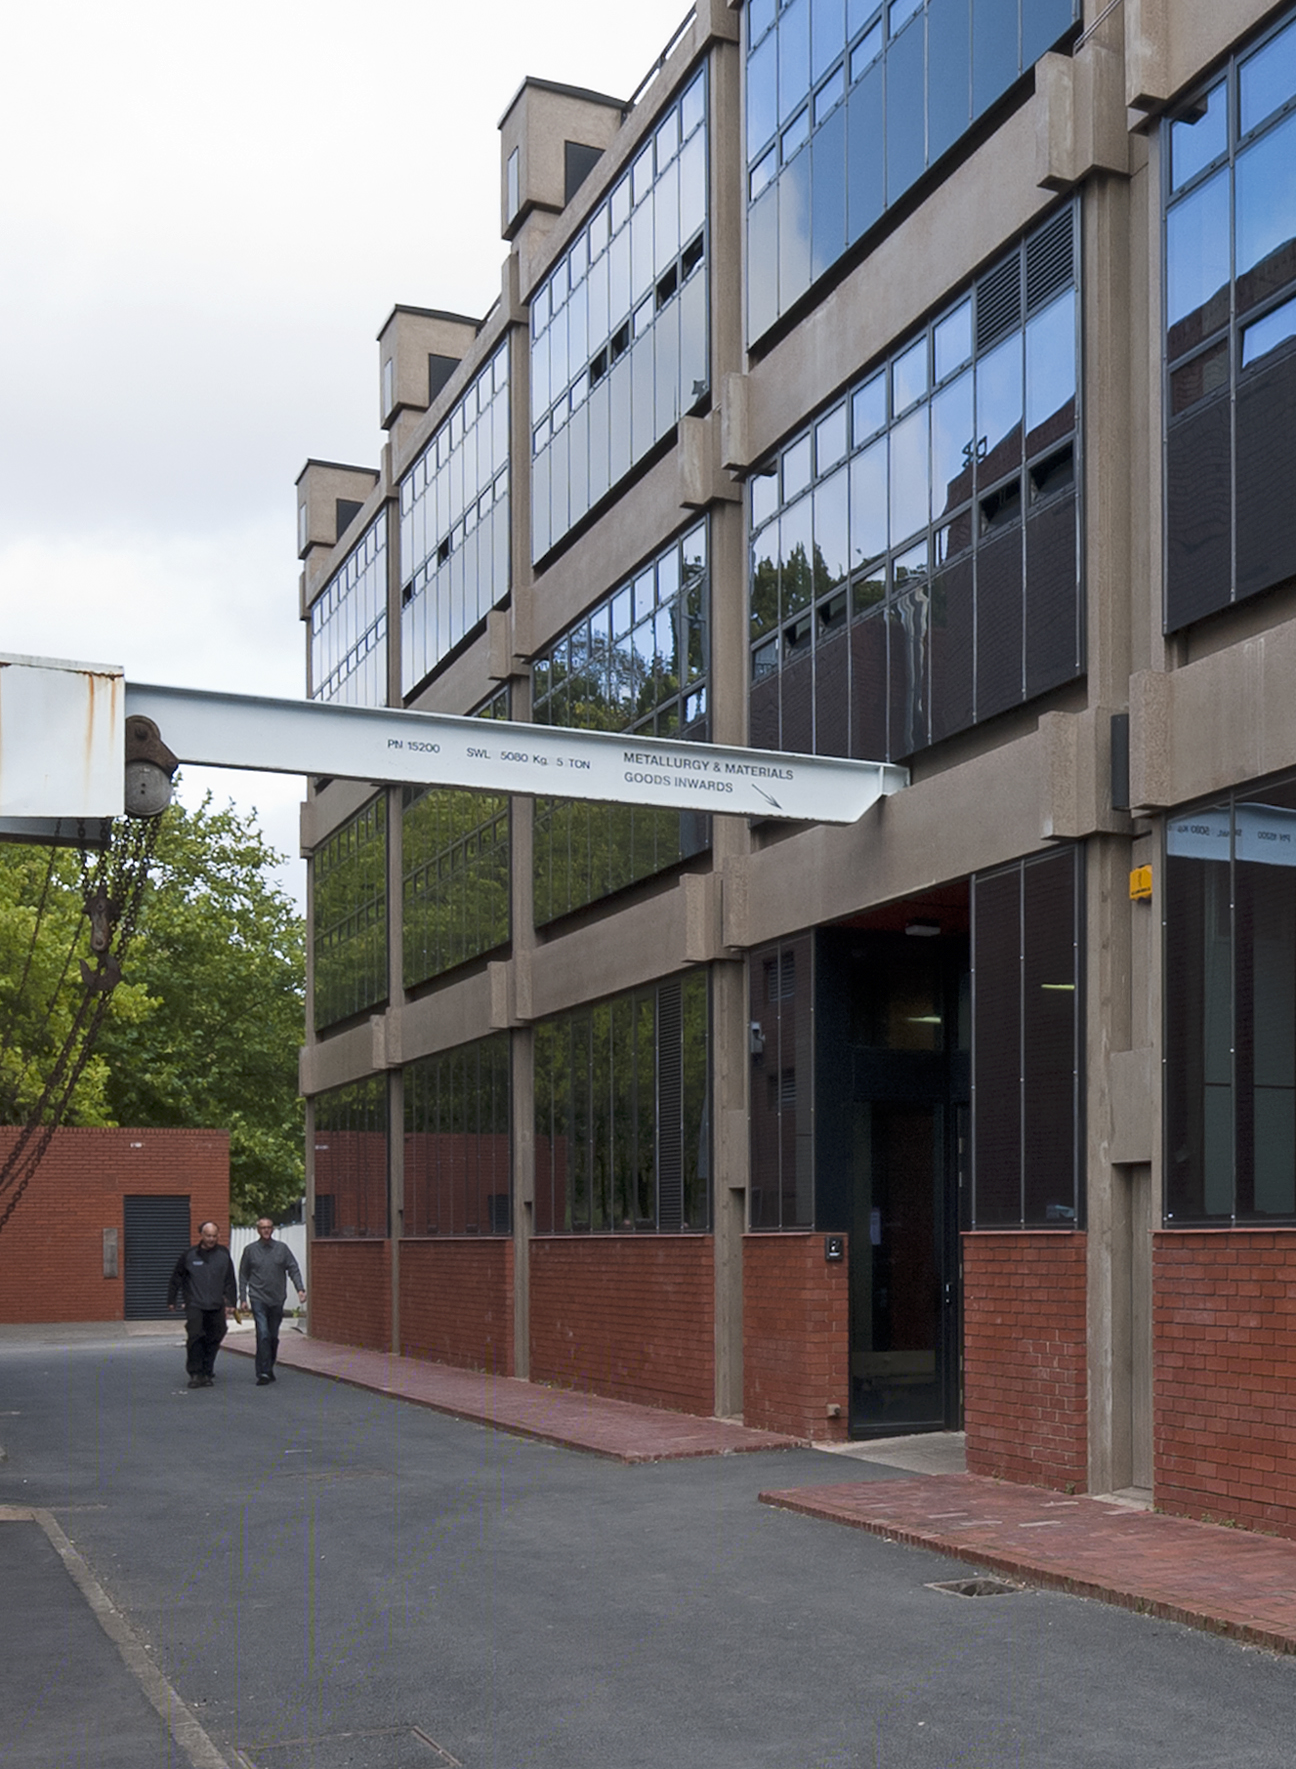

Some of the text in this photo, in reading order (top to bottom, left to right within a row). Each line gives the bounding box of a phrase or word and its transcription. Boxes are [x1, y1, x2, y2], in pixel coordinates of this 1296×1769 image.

[387, 738, 441, 753] PN 15200
[466, 747, 491, 760] SWL
[500, 750, 529, 763] 5080
[556, 757, 564, 767] 5
[568, 758, 591, 770] TON
[623, 751, 794, 781] METALLURGY & MATERIALS
[624, 771, 734, 793] GOODS INWARDS
